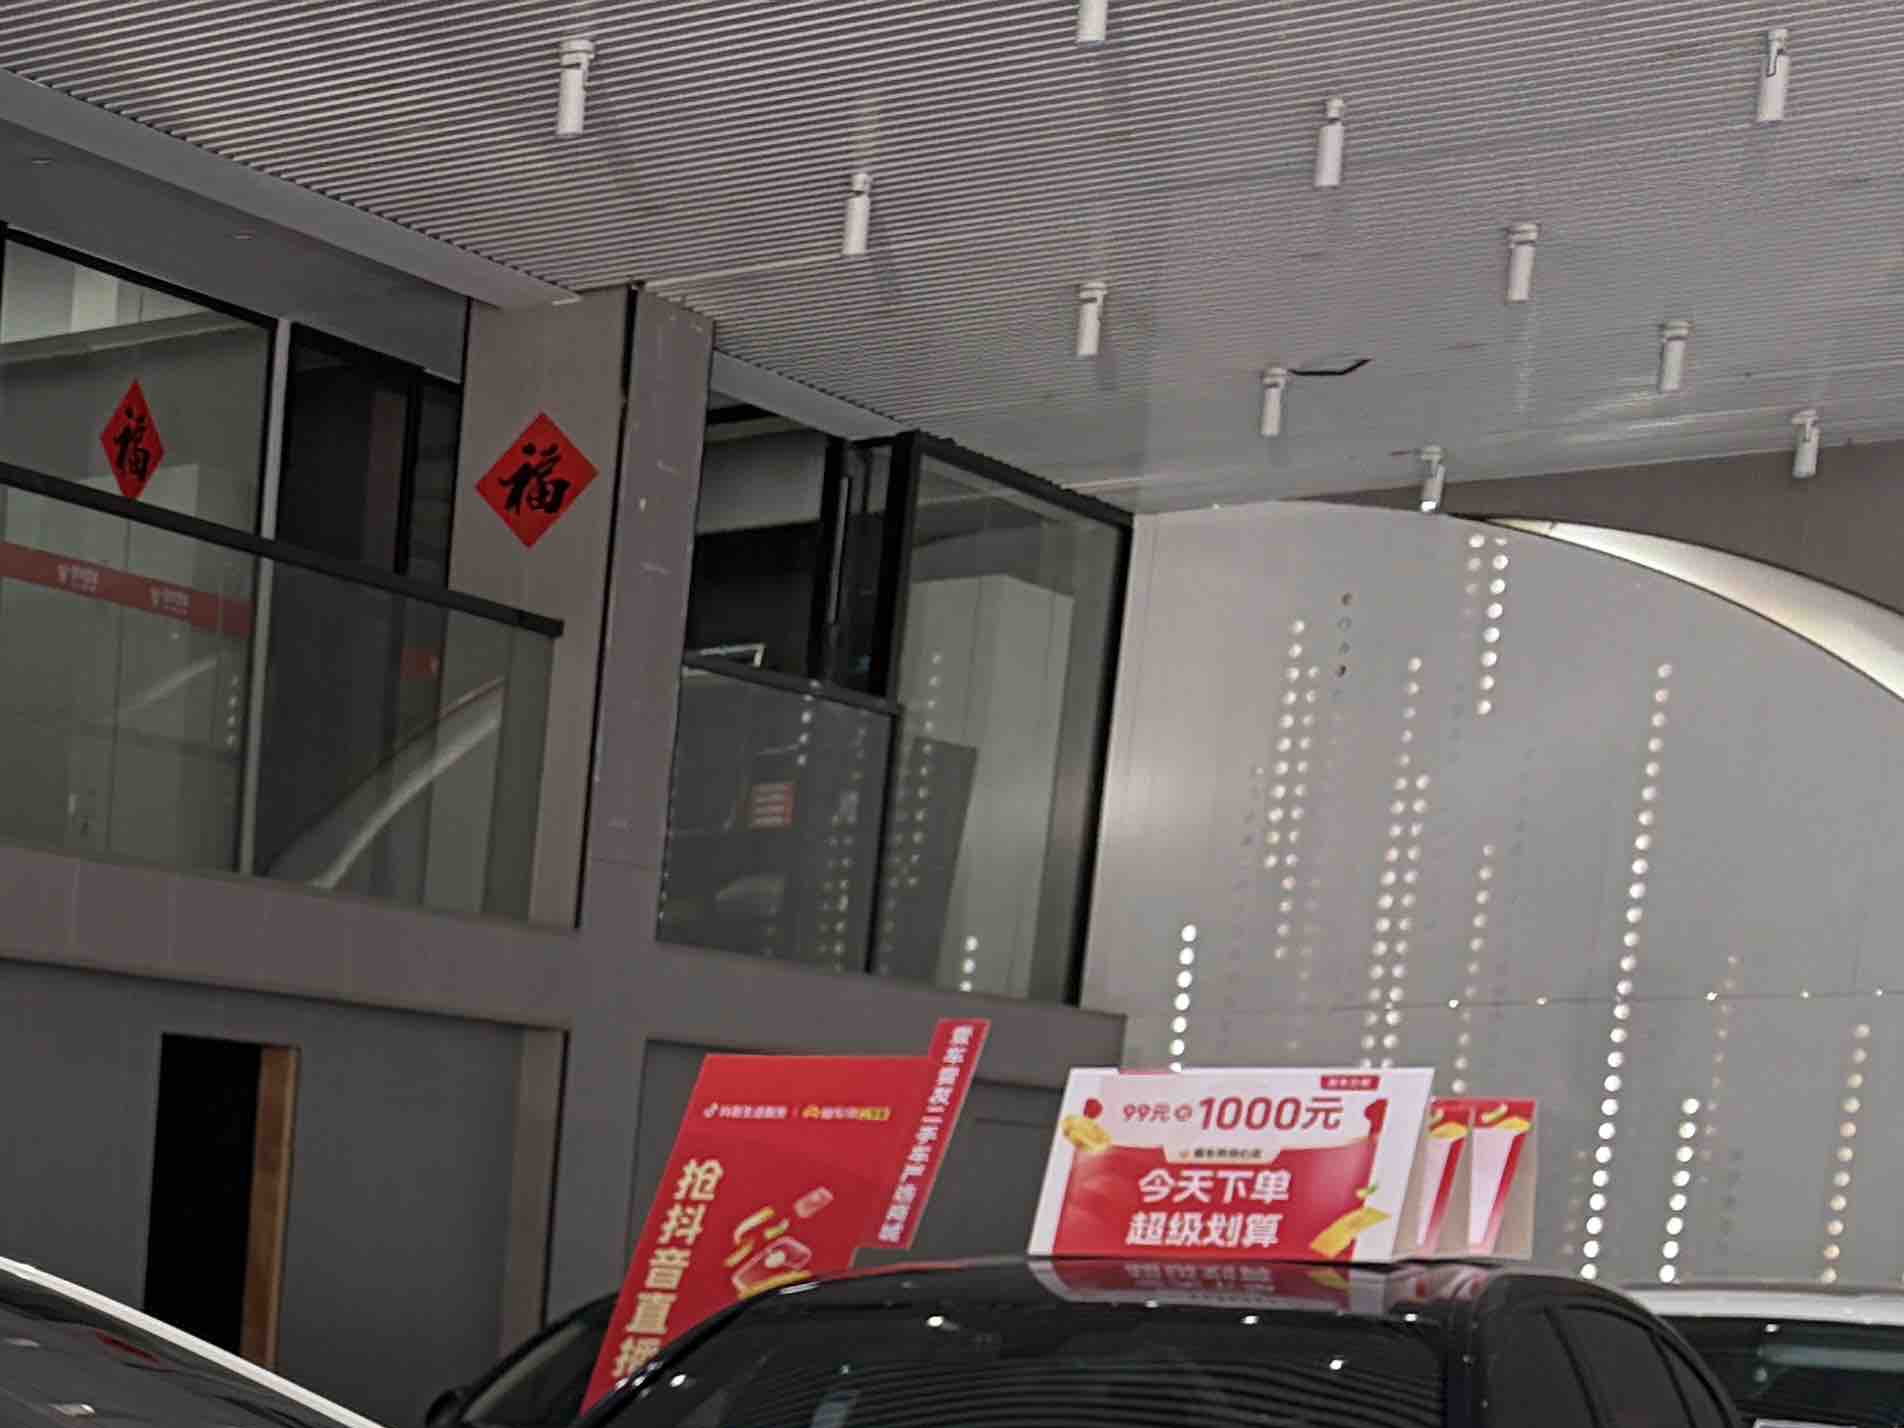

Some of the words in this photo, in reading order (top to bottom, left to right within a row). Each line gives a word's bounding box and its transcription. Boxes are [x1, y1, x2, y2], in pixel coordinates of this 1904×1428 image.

[496, 442, 571, 516] 福
[1138, 1168, 1292, 1205] 今天下单
[1125, 1210, 1284, 1248] 超级划算
